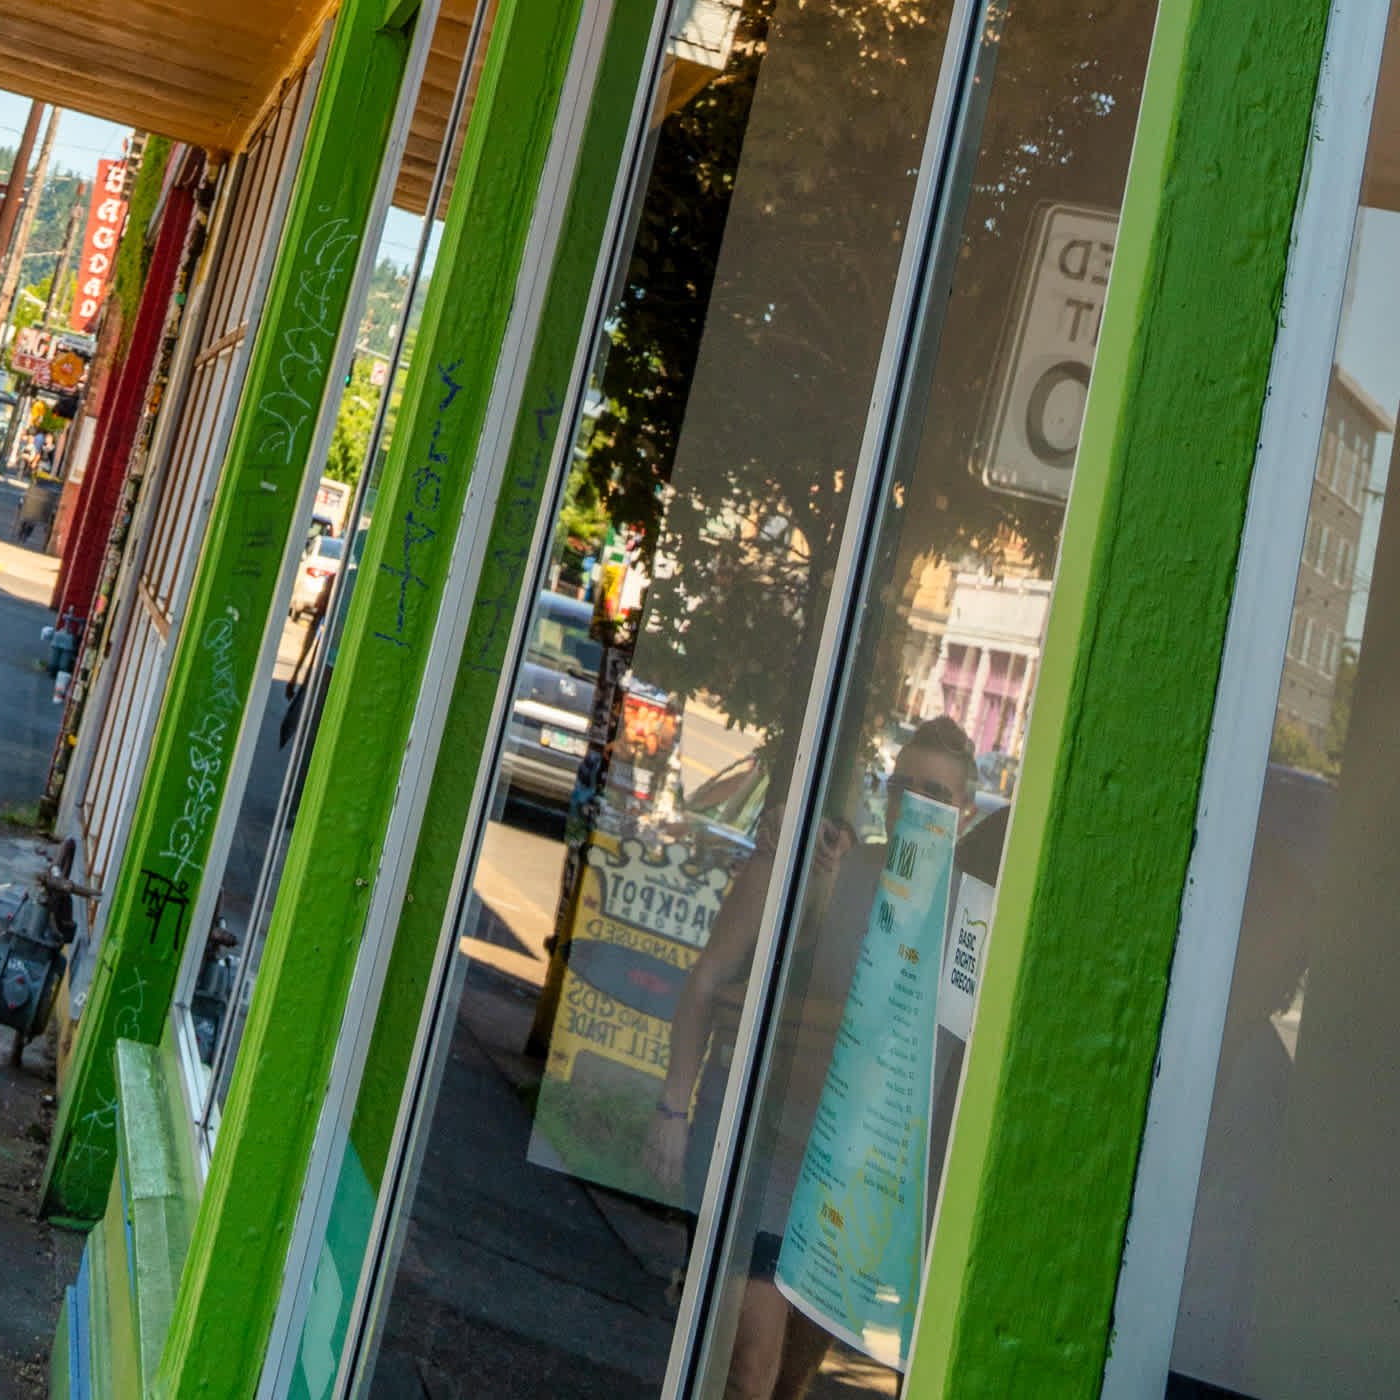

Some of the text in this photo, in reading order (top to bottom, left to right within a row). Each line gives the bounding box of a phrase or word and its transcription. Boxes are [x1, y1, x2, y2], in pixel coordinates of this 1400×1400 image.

[79, 164, 127, 318] BAGDAD
[958, 927, 977, 952] BASIC
[954, 947, 977, 975] RIGHTS
[950, 967, 976, 998] OREGON
